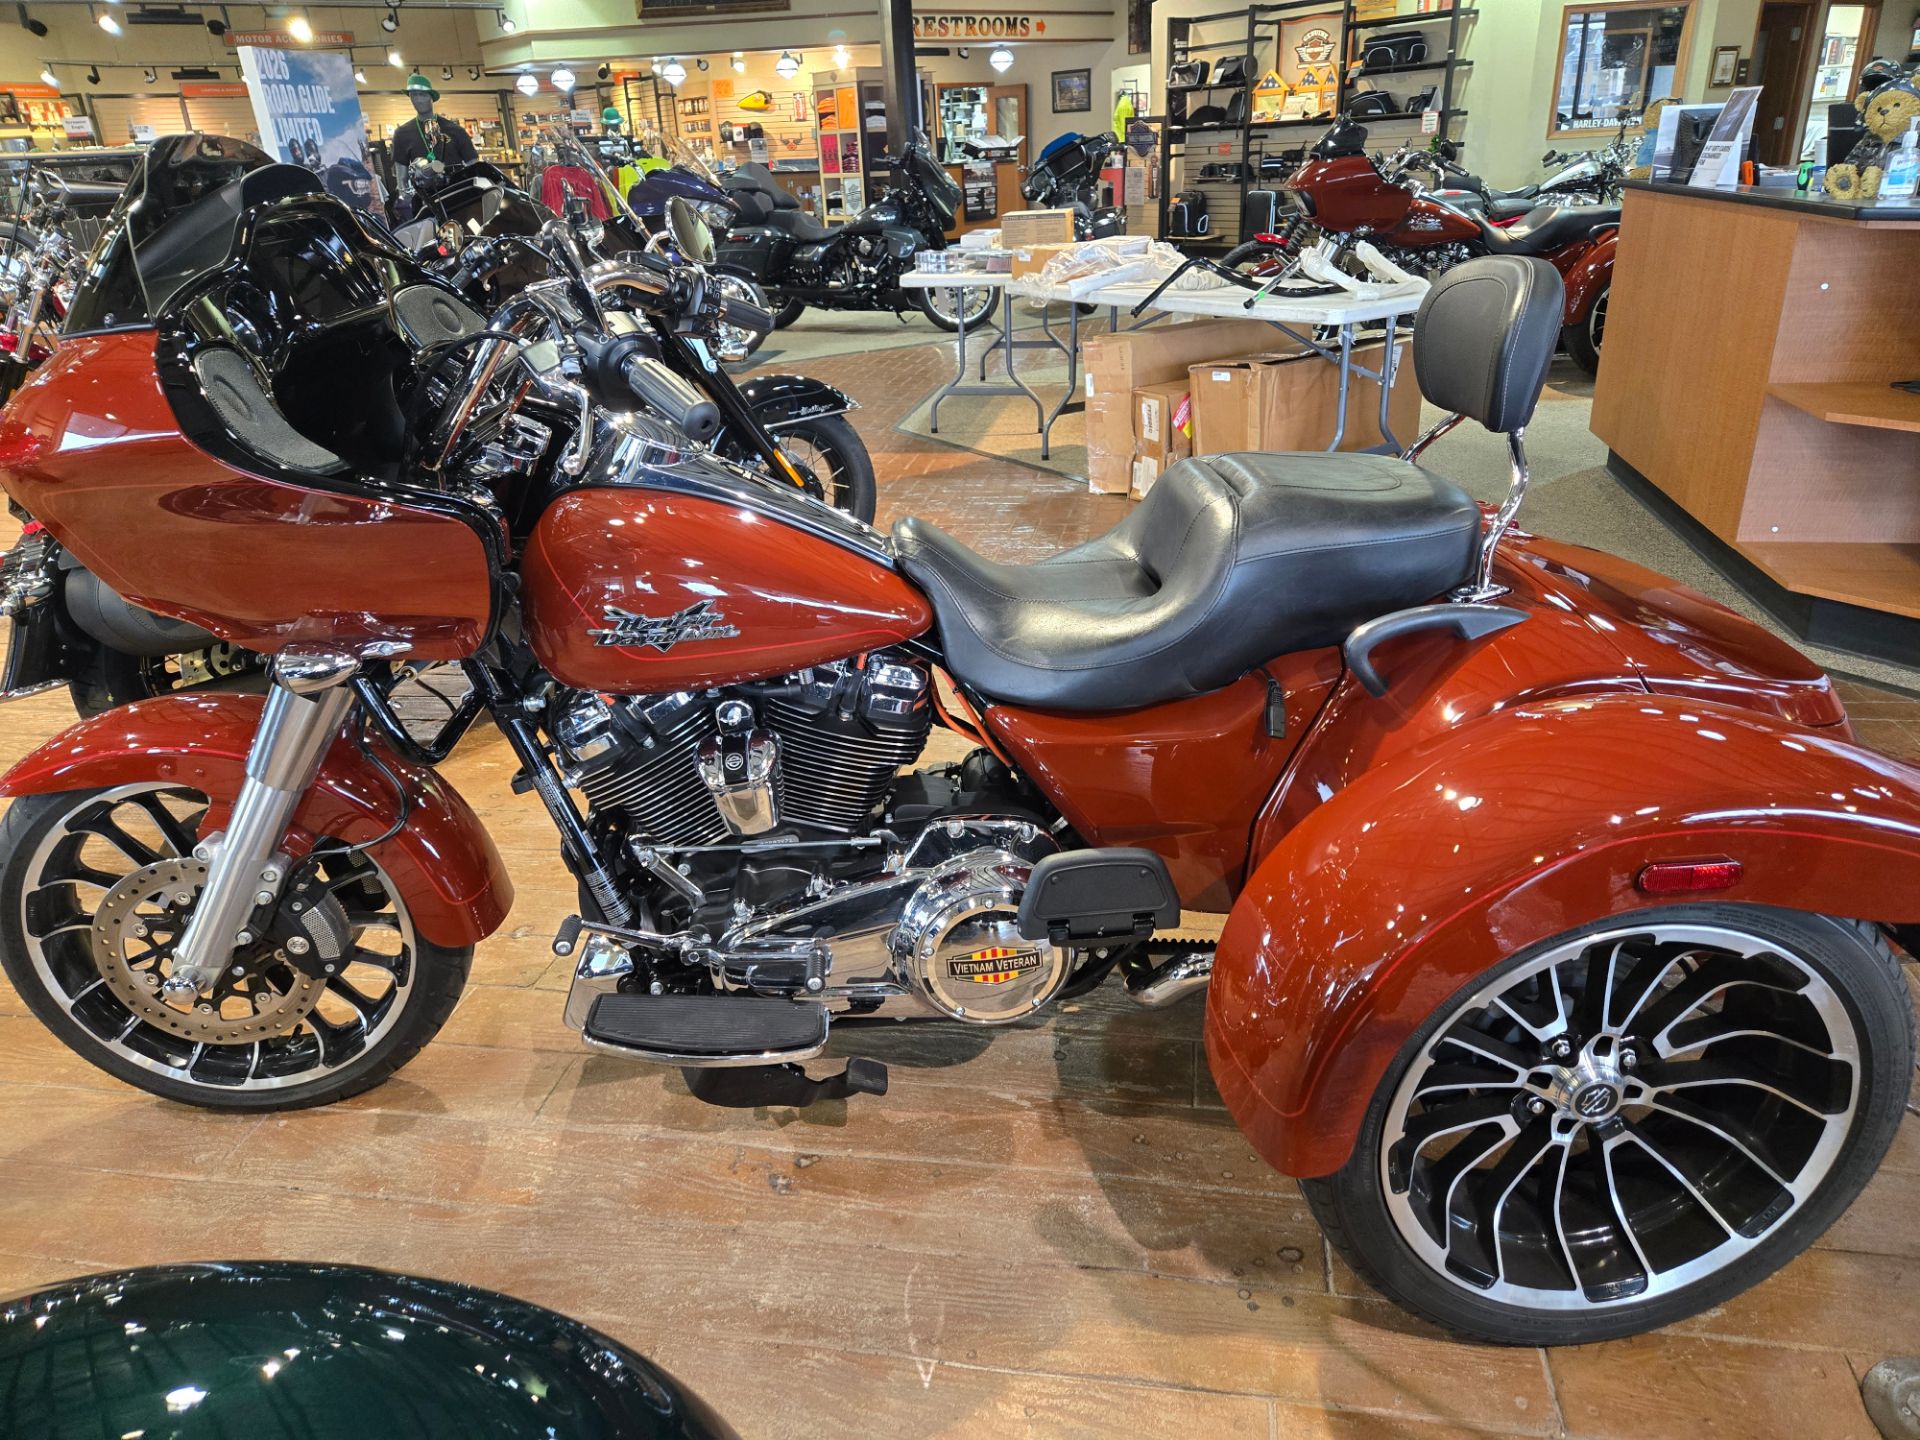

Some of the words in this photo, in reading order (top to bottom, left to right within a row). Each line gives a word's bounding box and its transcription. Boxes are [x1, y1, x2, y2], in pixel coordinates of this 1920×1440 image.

[235, 34, 272, 43] MOTOR
[275, 34, 343, 44] ACCORIES
[254, 50, 290, 80] 2026
[262, 84, 299, 113] ROAD
[297, 85, 336, 114] GLIDE
[271, 118, 324, 147] LIMITED
[954, 962, 994, 975] VIETNAM
[995, 954, 1037, 971] VETERAN
